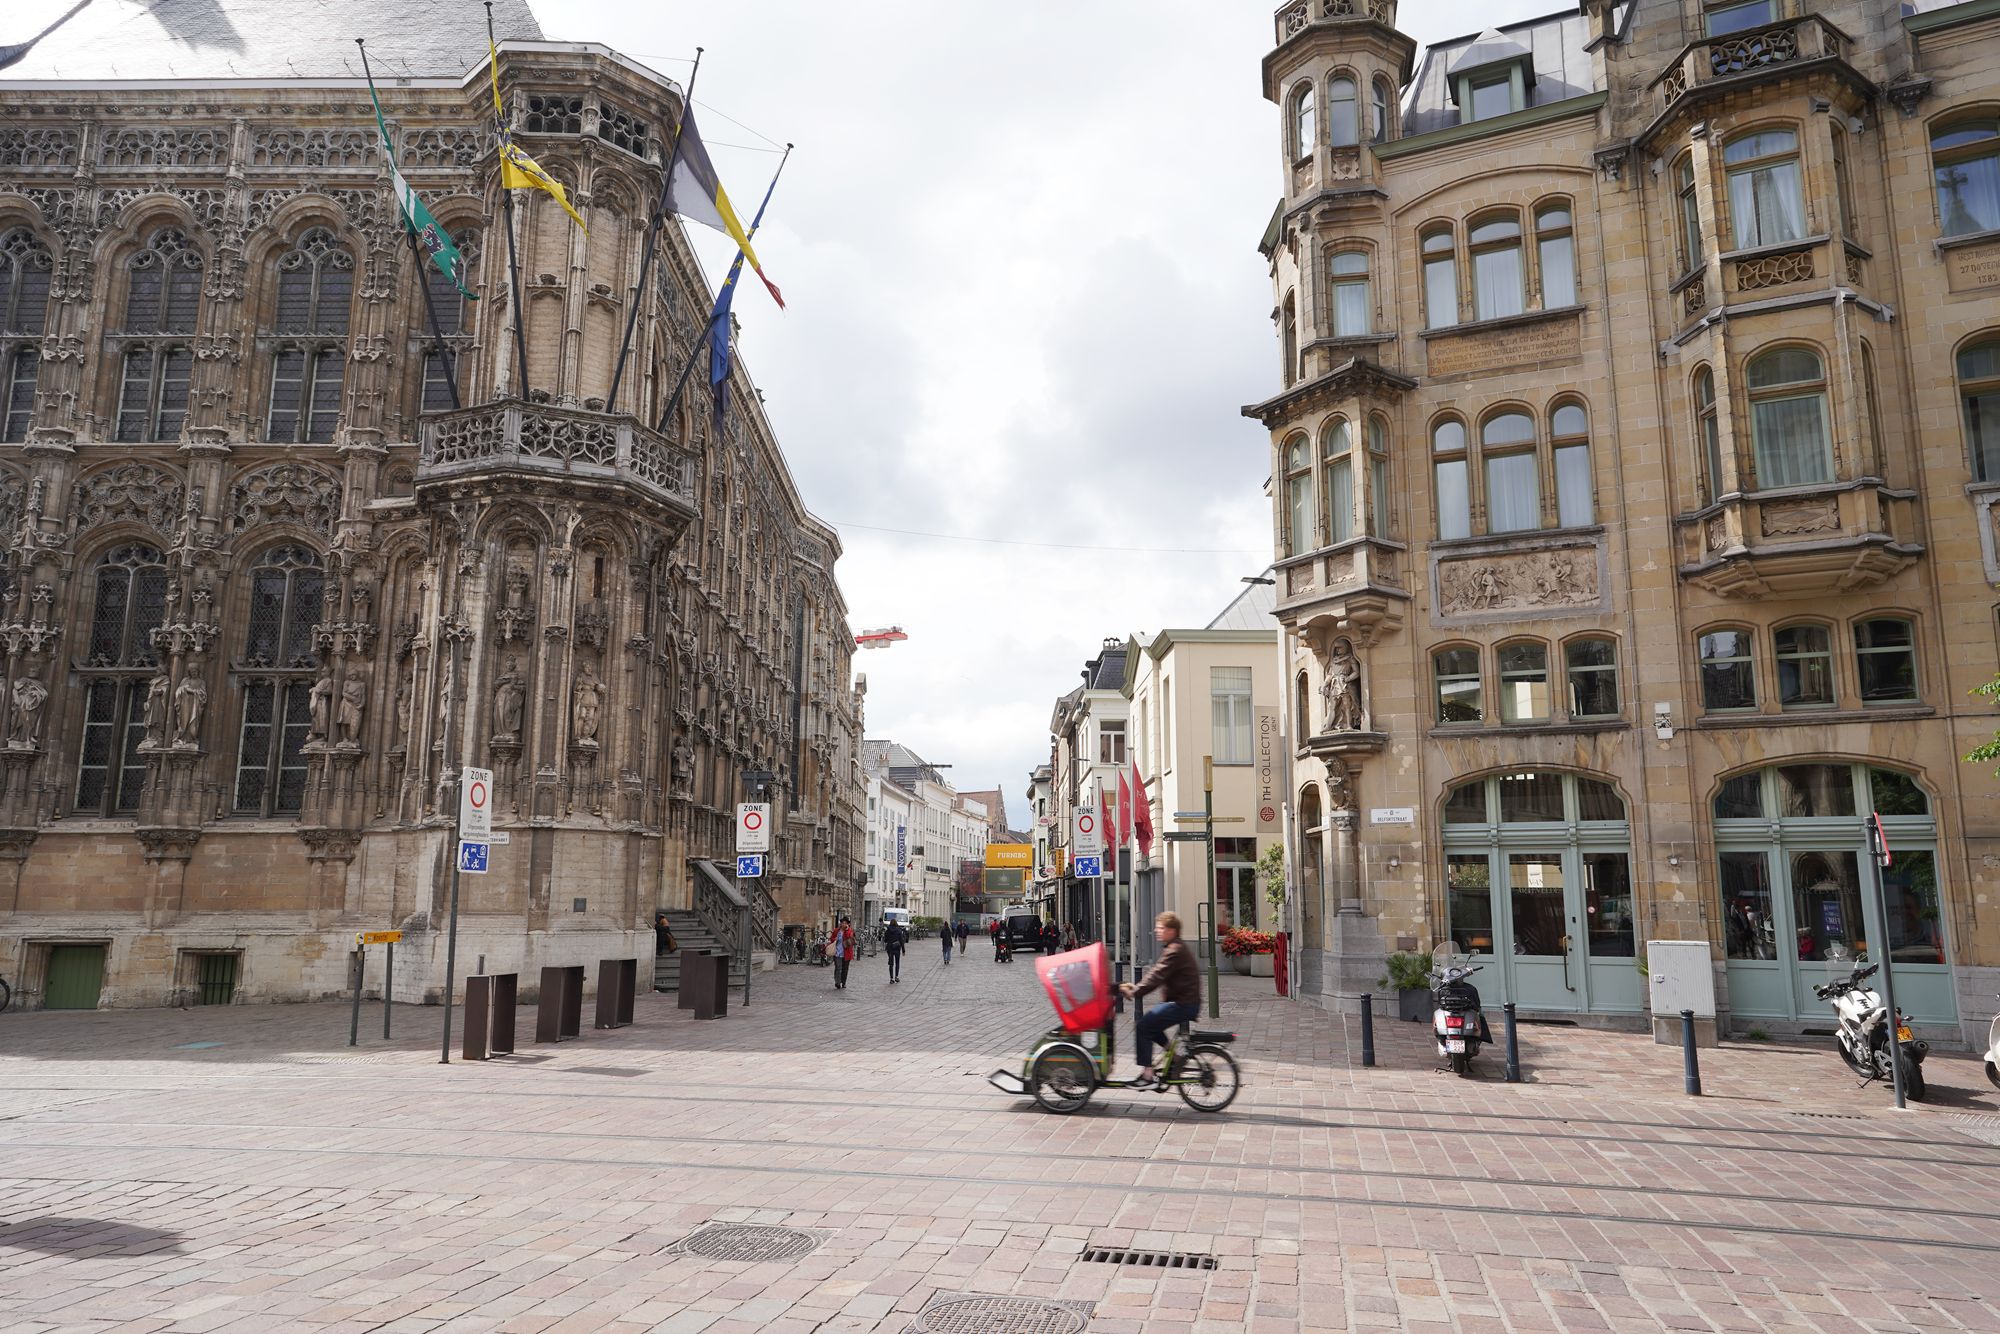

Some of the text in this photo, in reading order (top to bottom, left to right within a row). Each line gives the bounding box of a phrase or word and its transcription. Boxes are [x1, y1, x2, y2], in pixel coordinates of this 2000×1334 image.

[1978, 274, 1998, 284] 1382
[1261, 715, 1271, 784] COLLECTION
[470, 770, 488, 781] ZONE
[743, 804, 763, 812] ZONE
[898, 829, 906, 868] NOVOTEL
[997, 852, 1028, 860] FURNIBO
